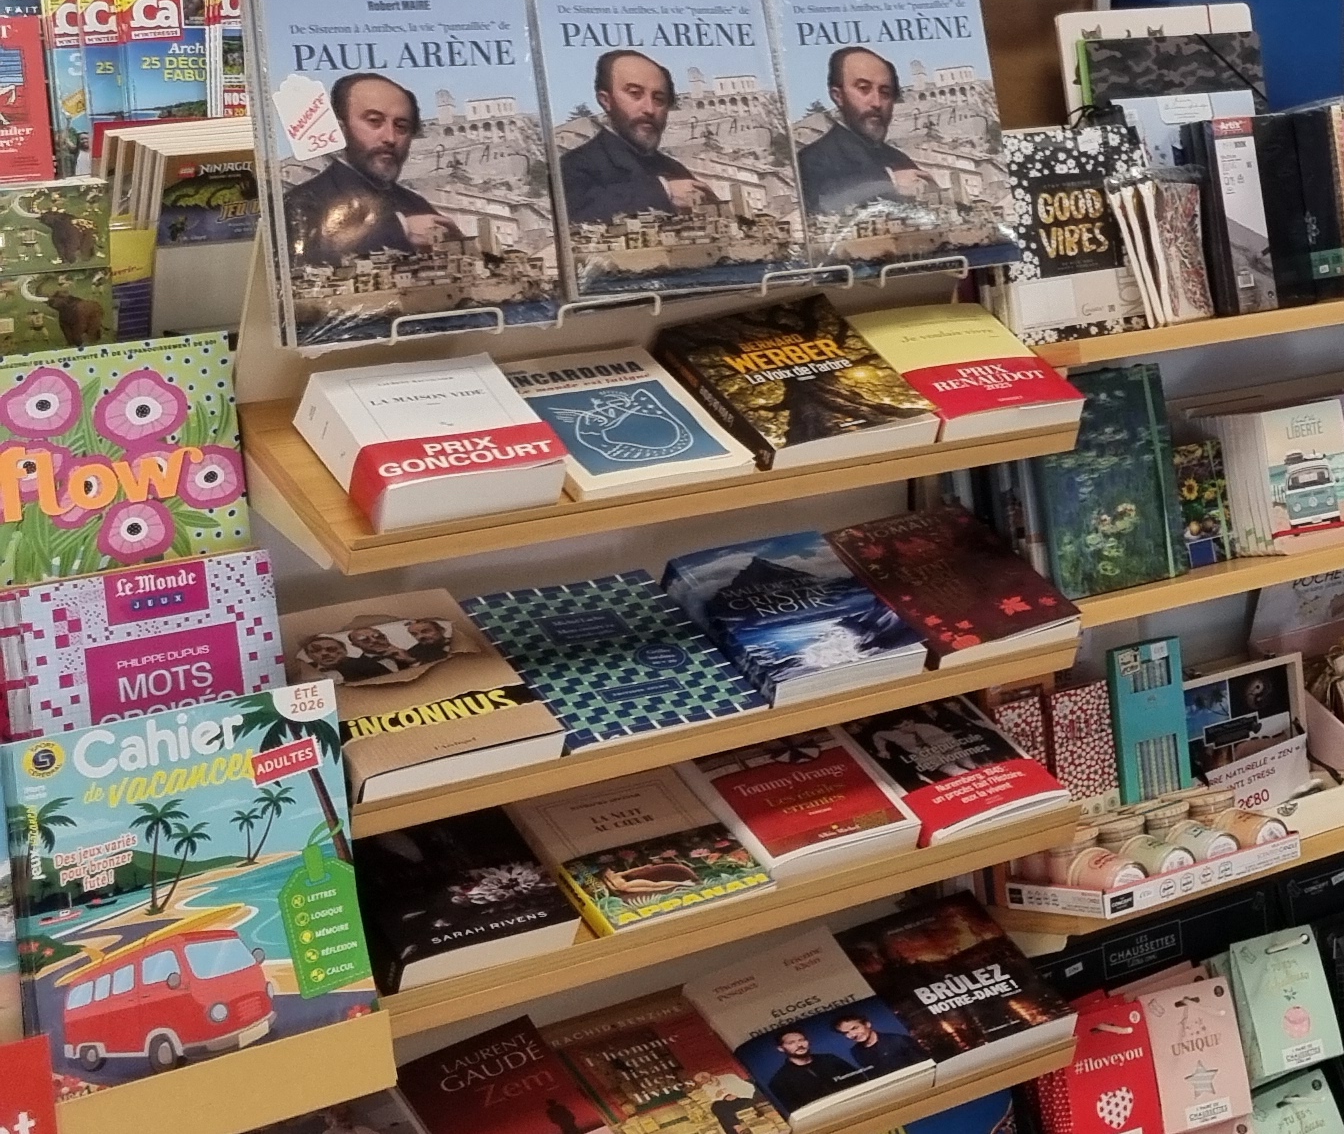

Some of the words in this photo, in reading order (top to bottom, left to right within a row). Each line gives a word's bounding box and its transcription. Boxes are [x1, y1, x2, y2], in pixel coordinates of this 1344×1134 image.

[560, 23, 644, 47] PAUL
[652, 18, 755, 47] ARÈNE
[292, 43, 387, 71] PAUL
[397, 35, 514, 68] ARÈNE
[1037, 188, 1103, 222] GOOD
[1039, 222, 1109, 259] VIBES
[722, 338, 846, 374] WERBER
[739, 334, 801, 352] BERNARD
[746, 372, 762, 386] La
[764, 367, 793, 384] Voix
[794, 365, 810, 378] de
[811, 358, 852, 375] l'arbre
[933, 369, 1045, 393] RENAUDOT
[958, 364, 1011, 378] PRIX
[378, 440, 551, 478] GONCOURT
[423, 436, 497, 457] PRIX
[0, 447, 203, 517] flow
[116, 577, 135, 598] Le
[137, 569, 197, 593] Monde
[757, 596, 835, 617] NOIR
[117, 652, 165, 670] PHILIPPE
[166, 644, 210, 662] DUPUIS
[119, 662, 214, 702] MOTS
[294, 683, 319, 700] ÉTÉ
[290, 697, 325, 713] 2026
[74, 712, 244, 780] Cahier
[256, 745, 314, 777] ADULTES
[107, 750, 256, 809] vacances
[1246, 767, 1276, 785] STRESS
[54, 852, 74, 868] Des
[76, 846, 102, 866] jeux
[102, 834, 138, 858] variés
[59, 866, 88, 887] pour
[90, 851, 132, 877] bronzer
[307, 889, 337, 903] LETTRES
[617, 871, 769, 927] APPANAH
[311, 906, 343, 920] LOGIQUE
[431, 925, 484, 946] SARAH
[487, 910, 548, 934] RIVENS
[315, 922, 349, 938] MÉMOIRE
[320, 941, 358, 957] RÉFLEXION
[1109, 934, 1176, 964] CHAUSSETTES
[326, 962, 355, 975] CALCUL
[913, 963, 1012, 1006] BRÛLEZ
[928, 984, 1008, 1015] NOTRE-DAME
[440, 1040, 545, 1094] GAUDÉ
[441, 1032, 528, 1075] LAURENT
[1074, 1047, 1144, 1075] #iloveyou
